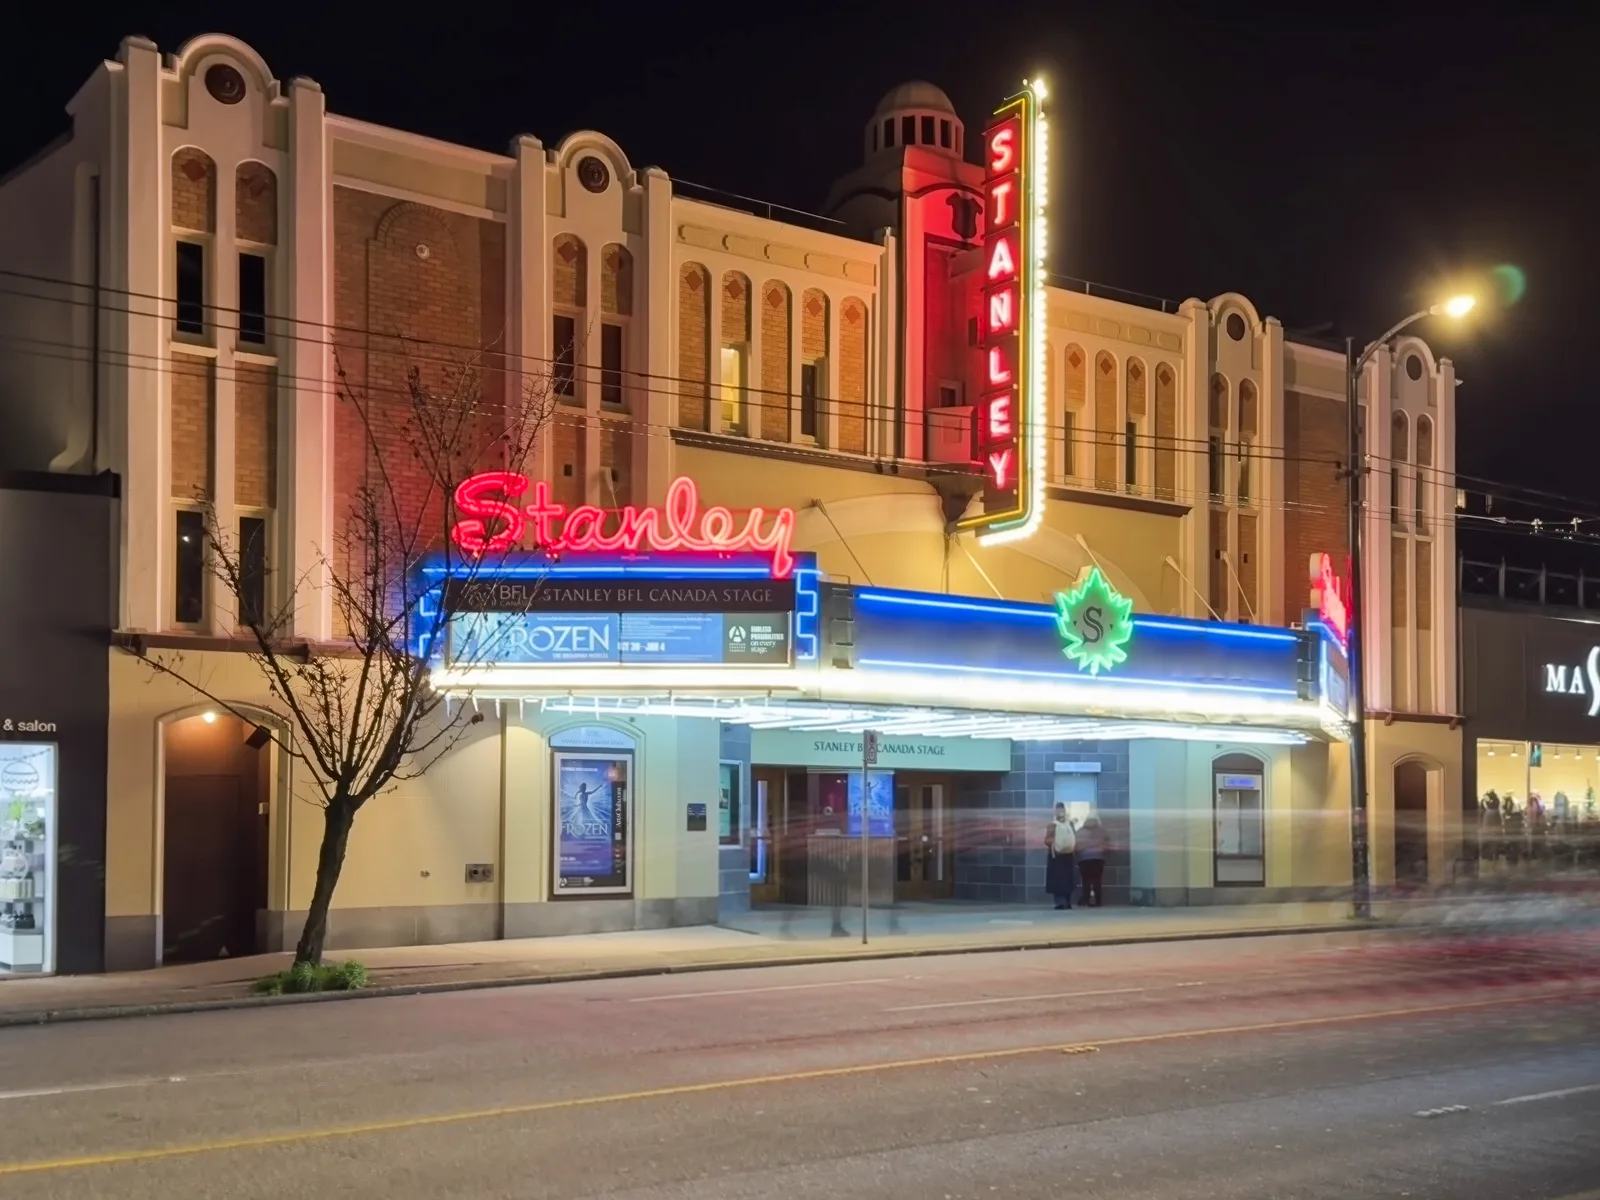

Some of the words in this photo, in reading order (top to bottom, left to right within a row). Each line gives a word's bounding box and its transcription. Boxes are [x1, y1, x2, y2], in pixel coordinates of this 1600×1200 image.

[988, 128, 1014, 490] STANLEY
[451, 471, 795, 578] Stanley
[500, 585, 528, 600] BFL
[540, 588, 612, 601] STANLEY
[617, 589, 643, 601] BFL
[650, 589, 718, 601] CANADA
[723, 589, 773, 601] STAGE
[1081, 605, 1104, 643] S
[3, 718, 14, 731] &
[18, 720, 57, 732] salon
[814, 741, 854, 752] STANLEY
[917, 746, 945, 755] STAGE
[560, 820, 609, 839] FROZEN
